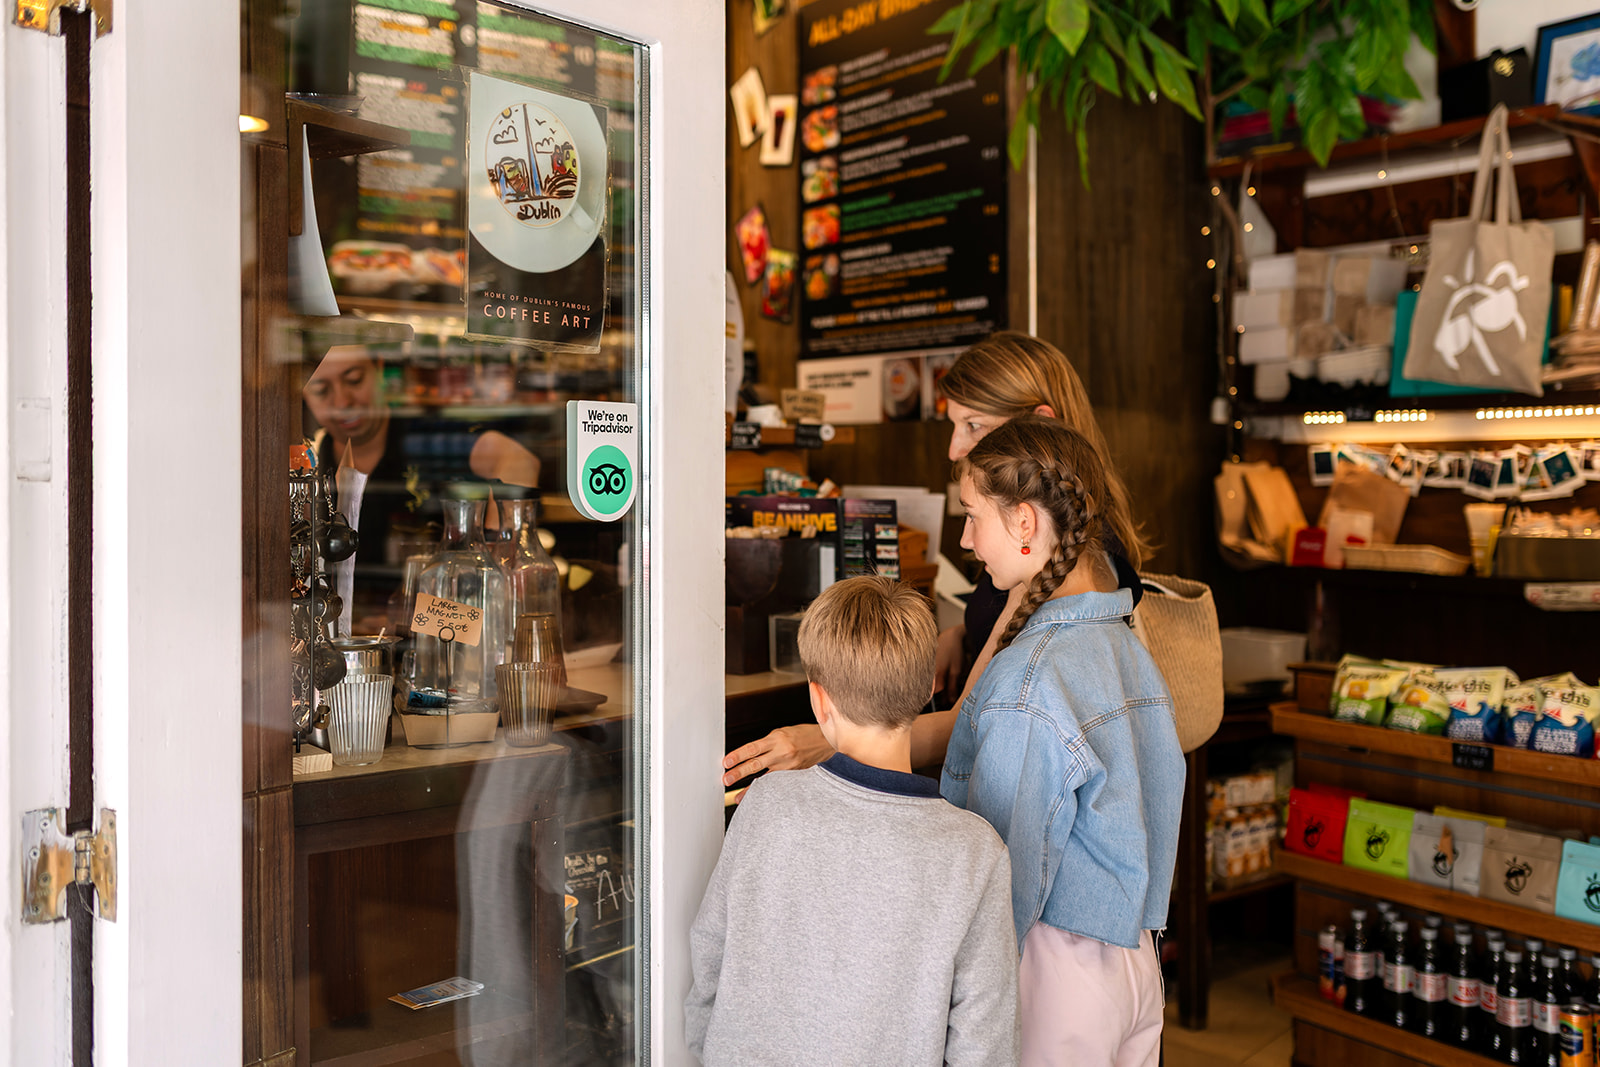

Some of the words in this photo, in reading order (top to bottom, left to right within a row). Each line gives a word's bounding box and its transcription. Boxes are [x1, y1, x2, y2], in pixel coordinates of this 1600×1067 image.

[517, 201, 561, 220] Dublin
[484, 290, 506, 301] HOME
[509, 294, 520, 302] OF
[523, 296, 559, 307] DUBLIN'S
[562, 301, 591, 312] FAMOUS
[483, 304, 550, 325] COFFEE
[561, 313, 591, 329] ART
[587, 409, 615, 422] We're
[616, 413, 628, 422] on
[581, 421, 634, 435] Tripadvisor
[752, 510, 838, 532] BEANHIVE
[426, 605, 466, 620] MAGNET
[431, 598, 459, 611] LARGE
